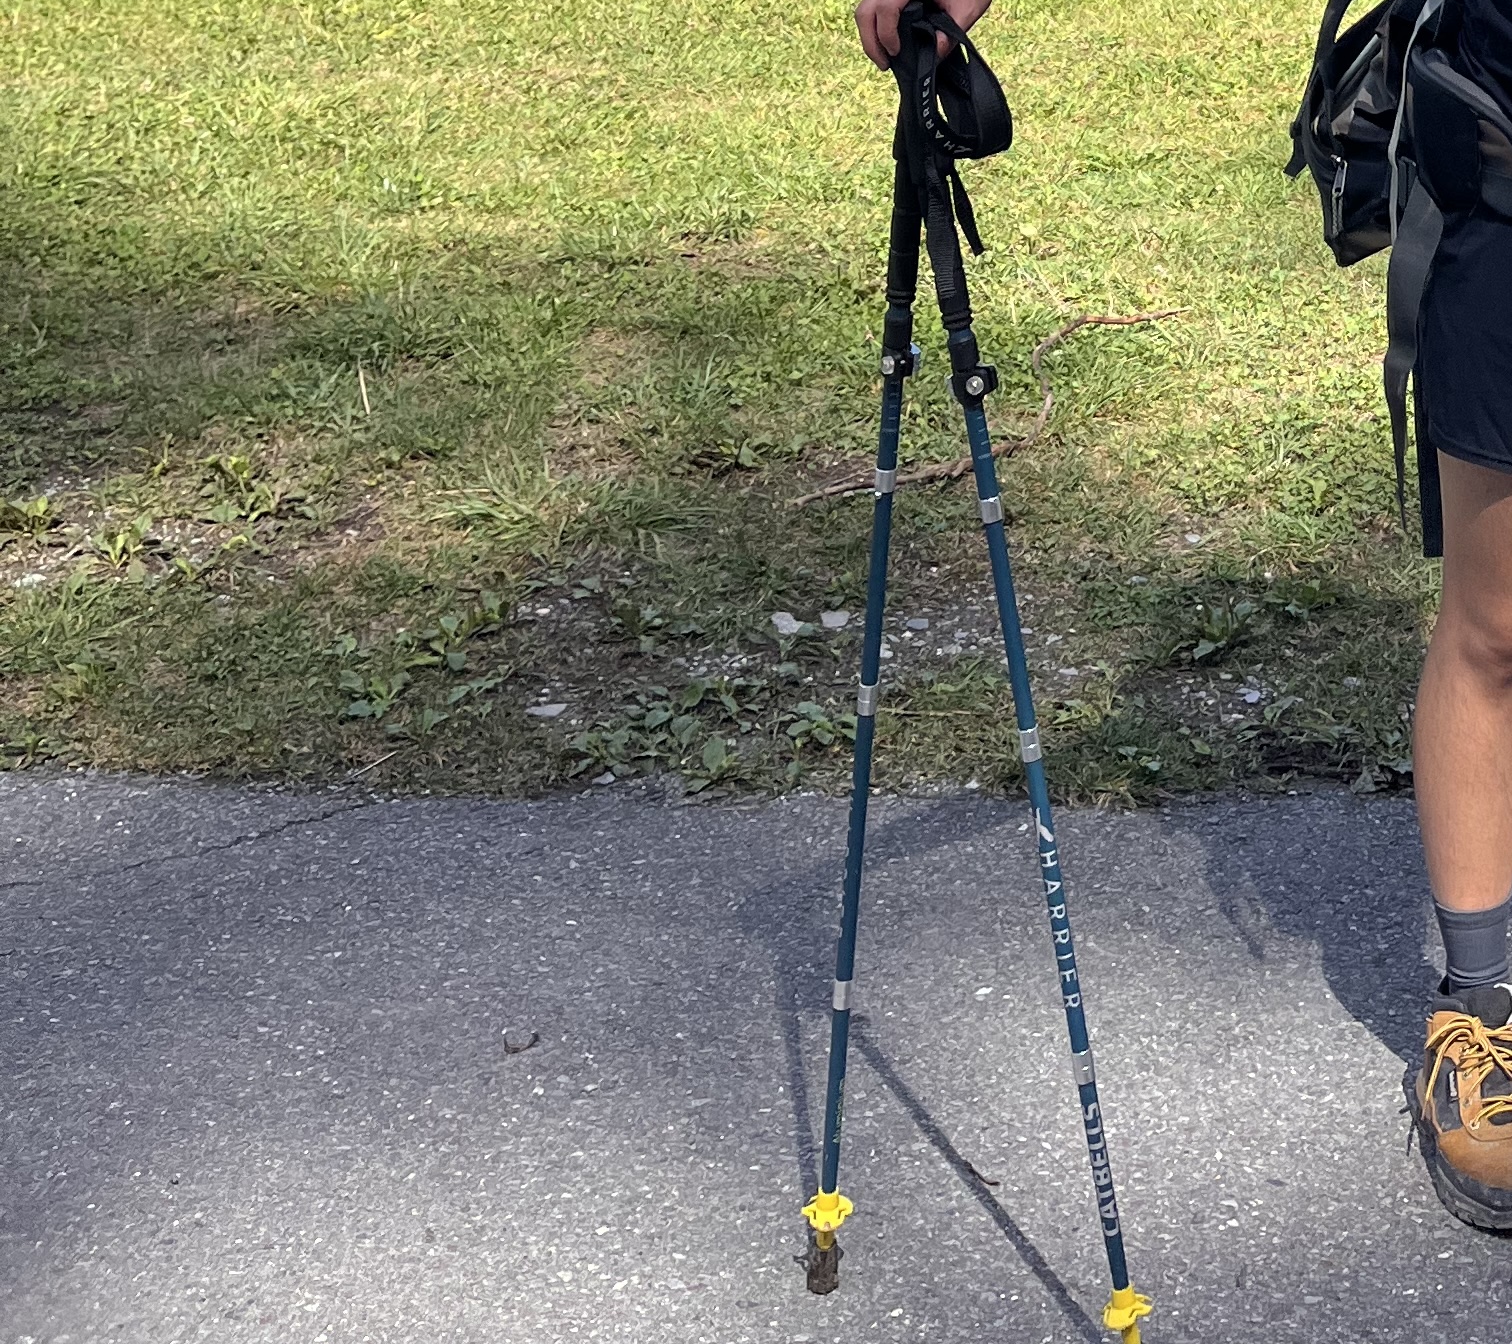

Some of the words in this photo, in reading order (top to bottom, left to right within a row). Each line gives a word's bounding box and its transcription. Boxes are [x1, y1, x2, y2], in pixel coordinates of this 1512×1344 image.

[922, 76, 956, 151] HARRIER
[1040, 849, 1081, 1009] HARRIER
[1081, 1101, 1120, 1237] CATBELLS
